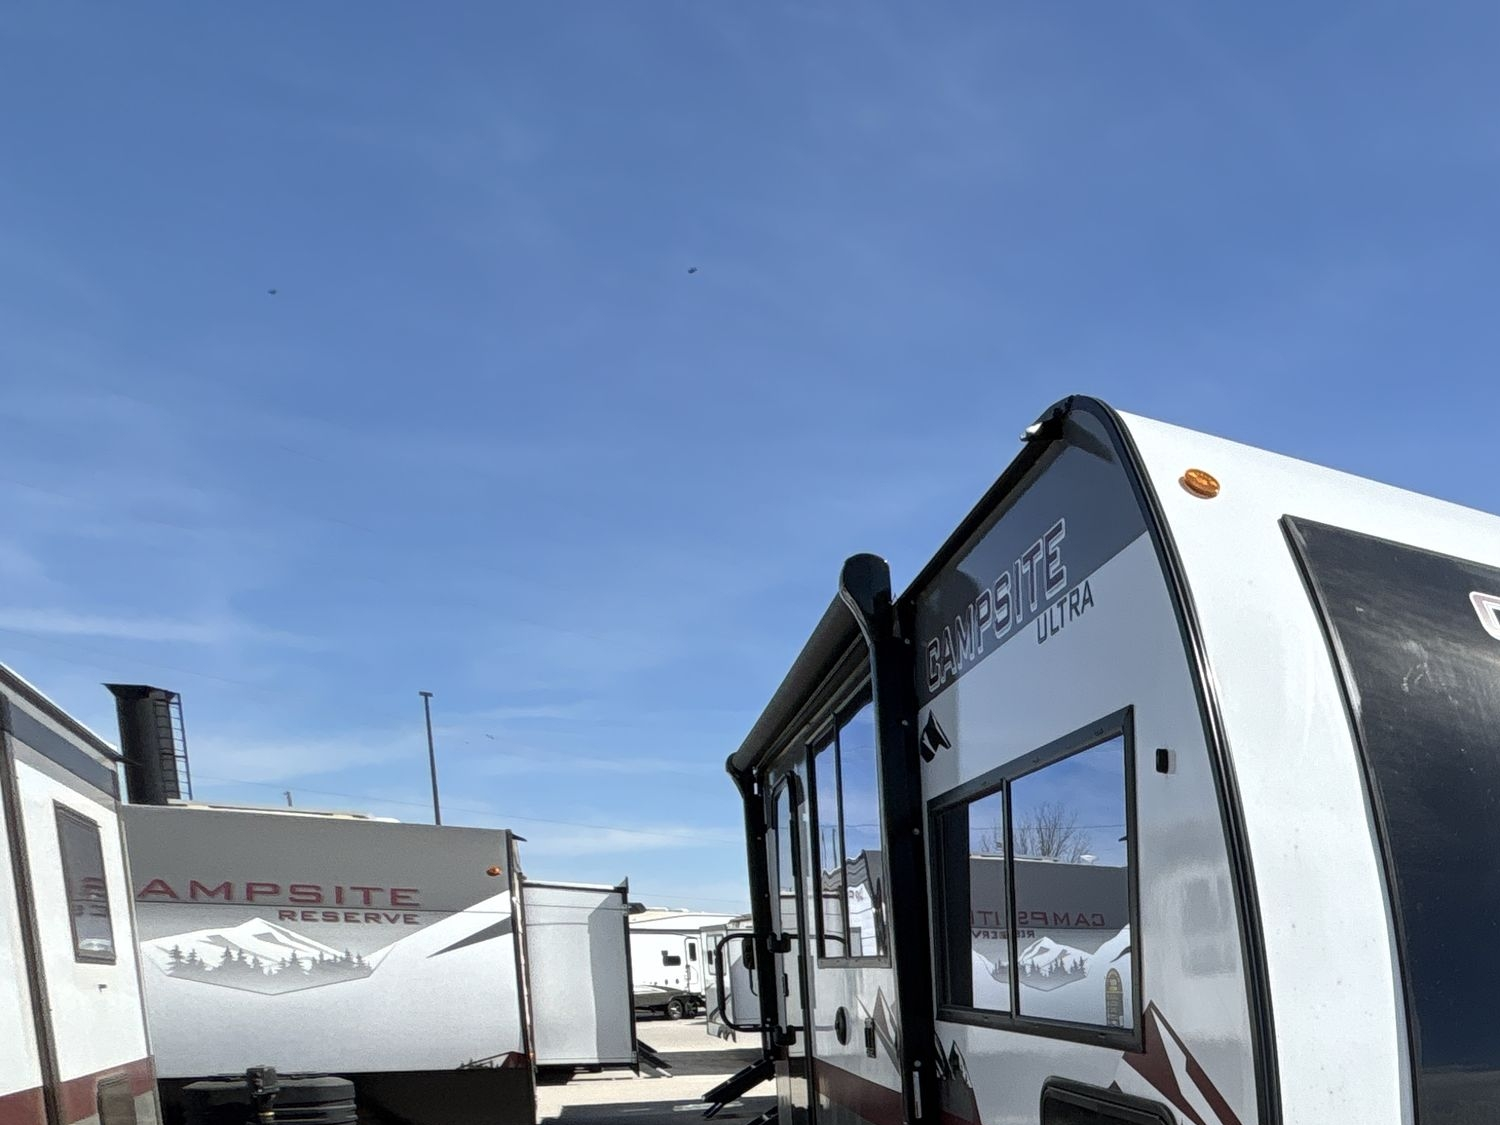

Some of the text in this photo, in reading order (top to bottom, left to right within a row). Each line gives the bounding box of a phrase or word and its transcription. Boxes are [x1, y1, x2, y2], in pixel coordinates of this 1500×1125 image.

[926, 517, 1067, 693] CAMPSITE
[1036, 579, 1095, 645] ULTRA
[136, 878, 421, 907] AMPSITE
[277, 909, 421, 925] RESERVE
